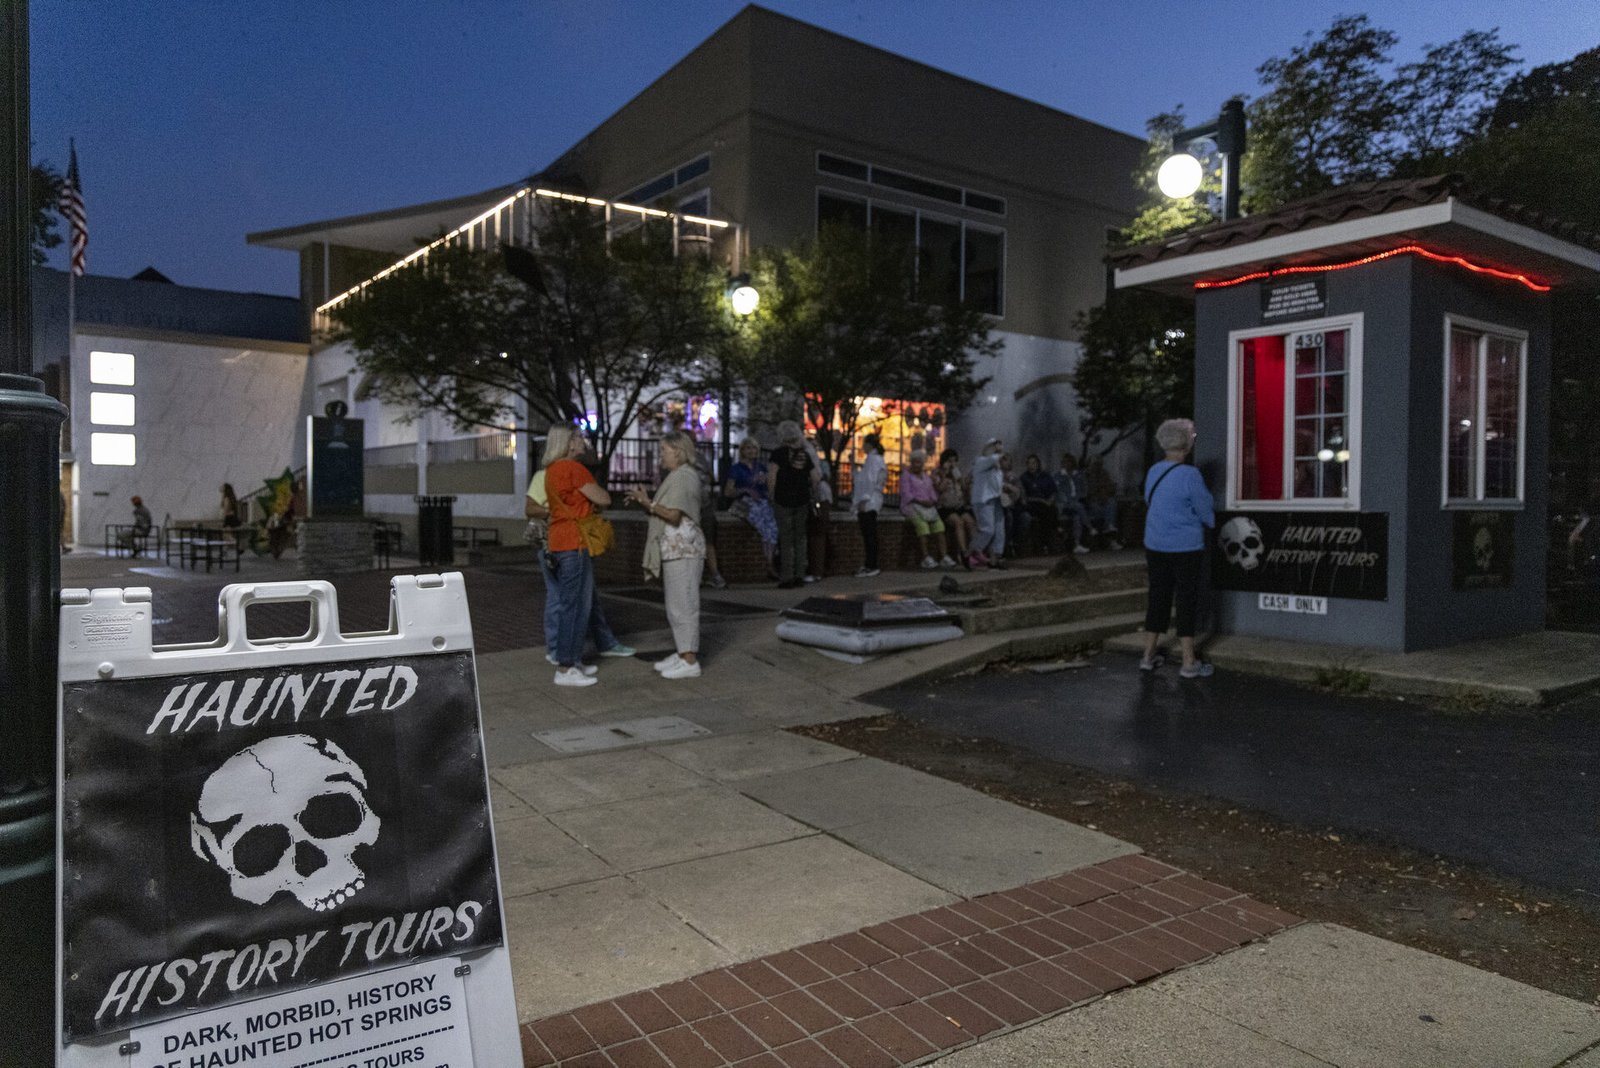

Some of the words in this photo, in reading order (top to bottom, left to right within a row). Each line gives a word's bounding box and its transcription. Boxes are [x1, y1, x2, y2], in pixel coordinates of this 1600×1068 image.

[1296, 333, 1323, 347] 430
[1280, 526, 1362, 544] HAUNTED
[1265, 549, 1324, 564] HISTORY
[1330, 551, 1380, 567] TOURS
[1263, 595, 1289, 609] CASH
[1295, 599, 1324, 613] ONLY
[146, 665, 418, 734] HAUNTED
[94, 930, 328, 1020] HISTORY
[338, 900, 483, 967] TOURS
[164, 1022, 238, 1054] DARK,
[246, 998, 341, 1034] MORBID,
[348, 974, 436, 1010] HISTORY
[190, 1031, 302, 1068] HAUNTED
[309, 1018, 354, 1044] HOT
[361, 995, 452, 1031] SPRINGS
[363, 1046, 425, 1068] TOURS
